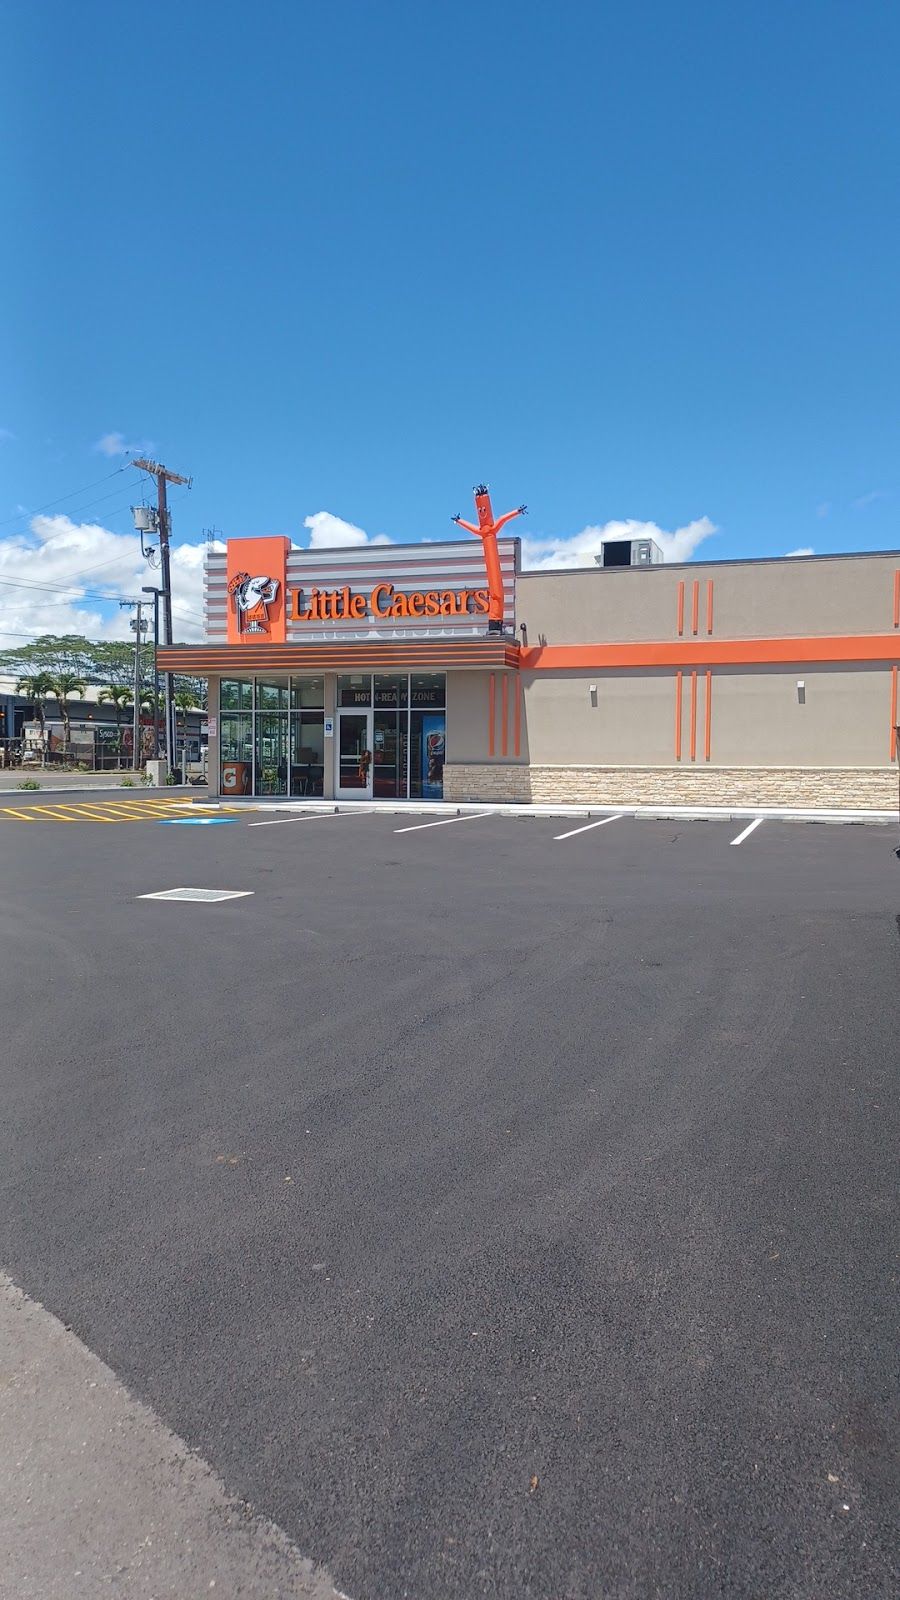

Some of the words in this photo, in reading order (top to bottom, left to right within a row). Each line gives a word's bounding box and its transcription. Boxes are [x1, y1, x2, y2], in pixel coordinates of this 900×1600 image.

[289, 586, 367, 620] Little
[371, 583, 489, 618] Caesars
[412, 691, 436, 701] ZONE
